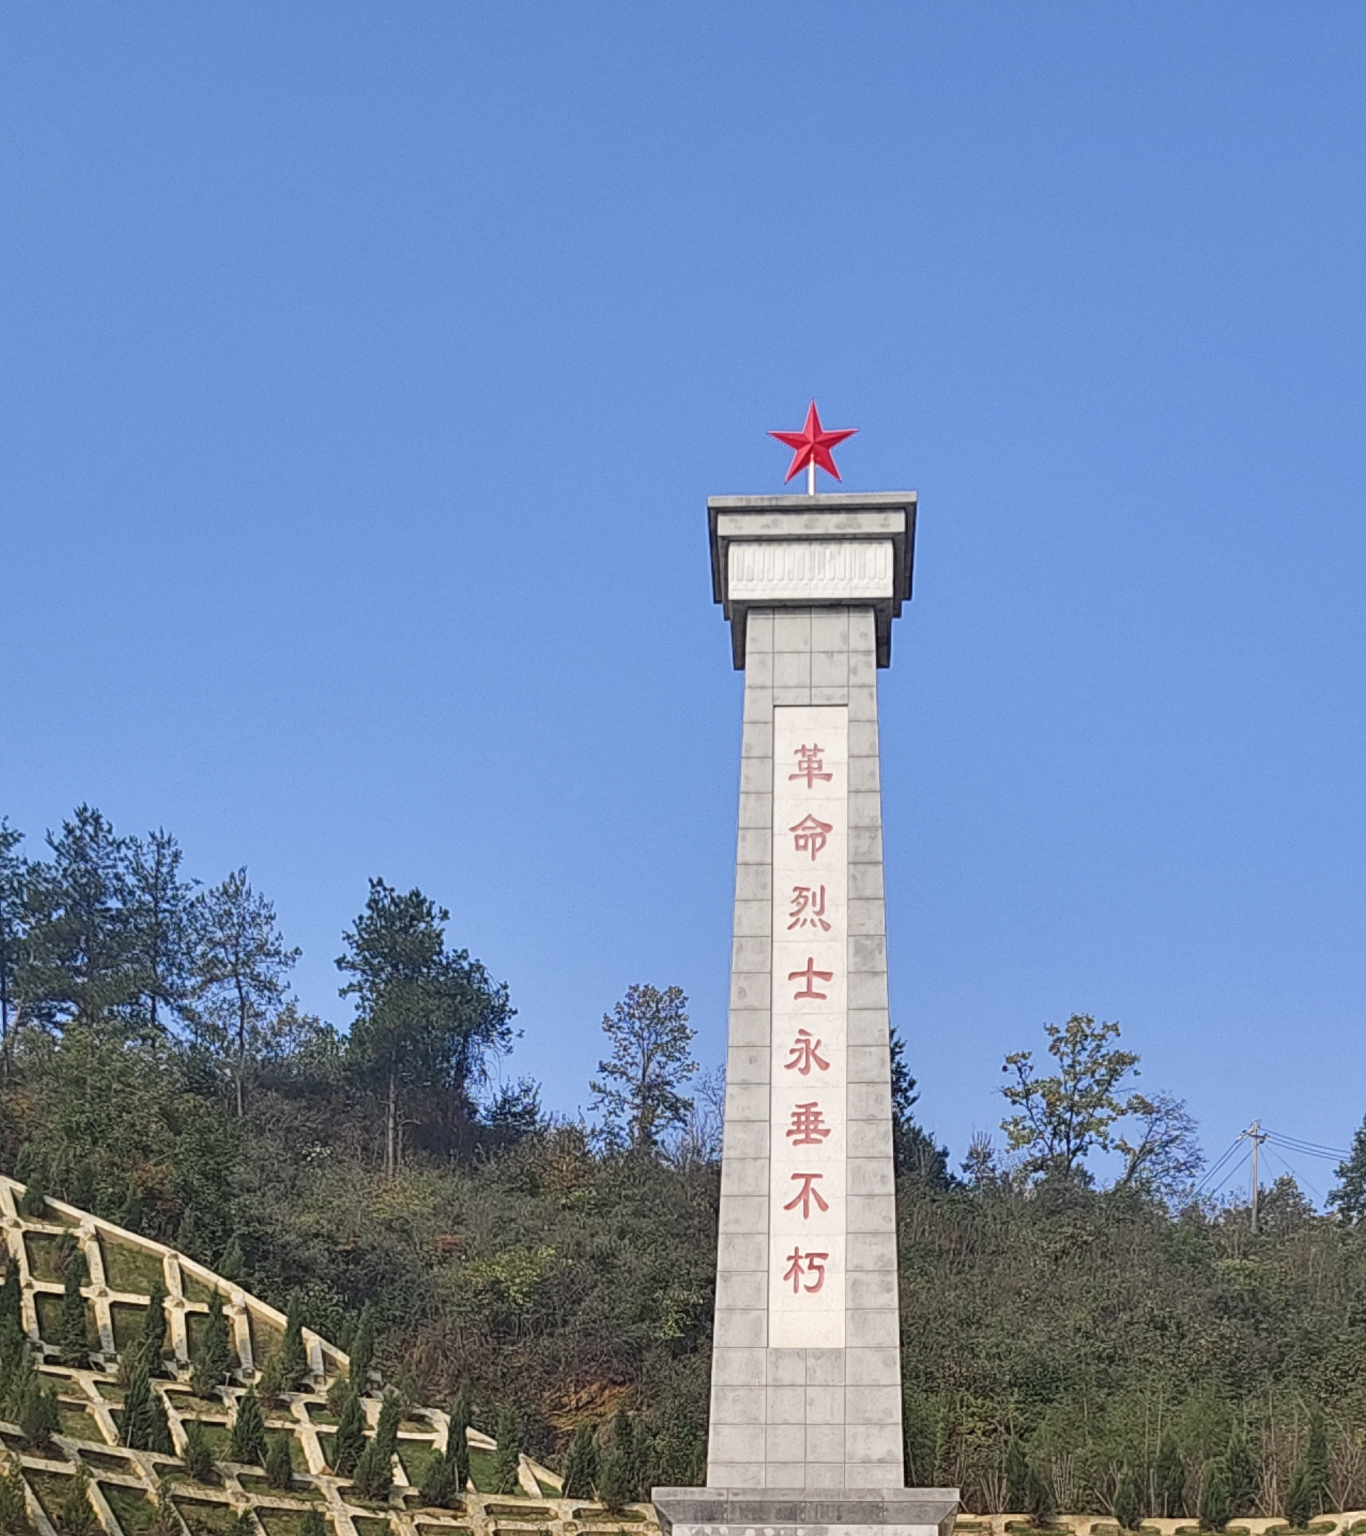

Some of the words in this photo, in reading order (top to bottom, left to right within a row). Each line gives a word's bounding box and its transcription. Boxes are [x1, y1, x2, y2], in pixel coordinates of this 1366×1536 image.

[783, 743, 834, 1294] 革命烈士永垂不朽
